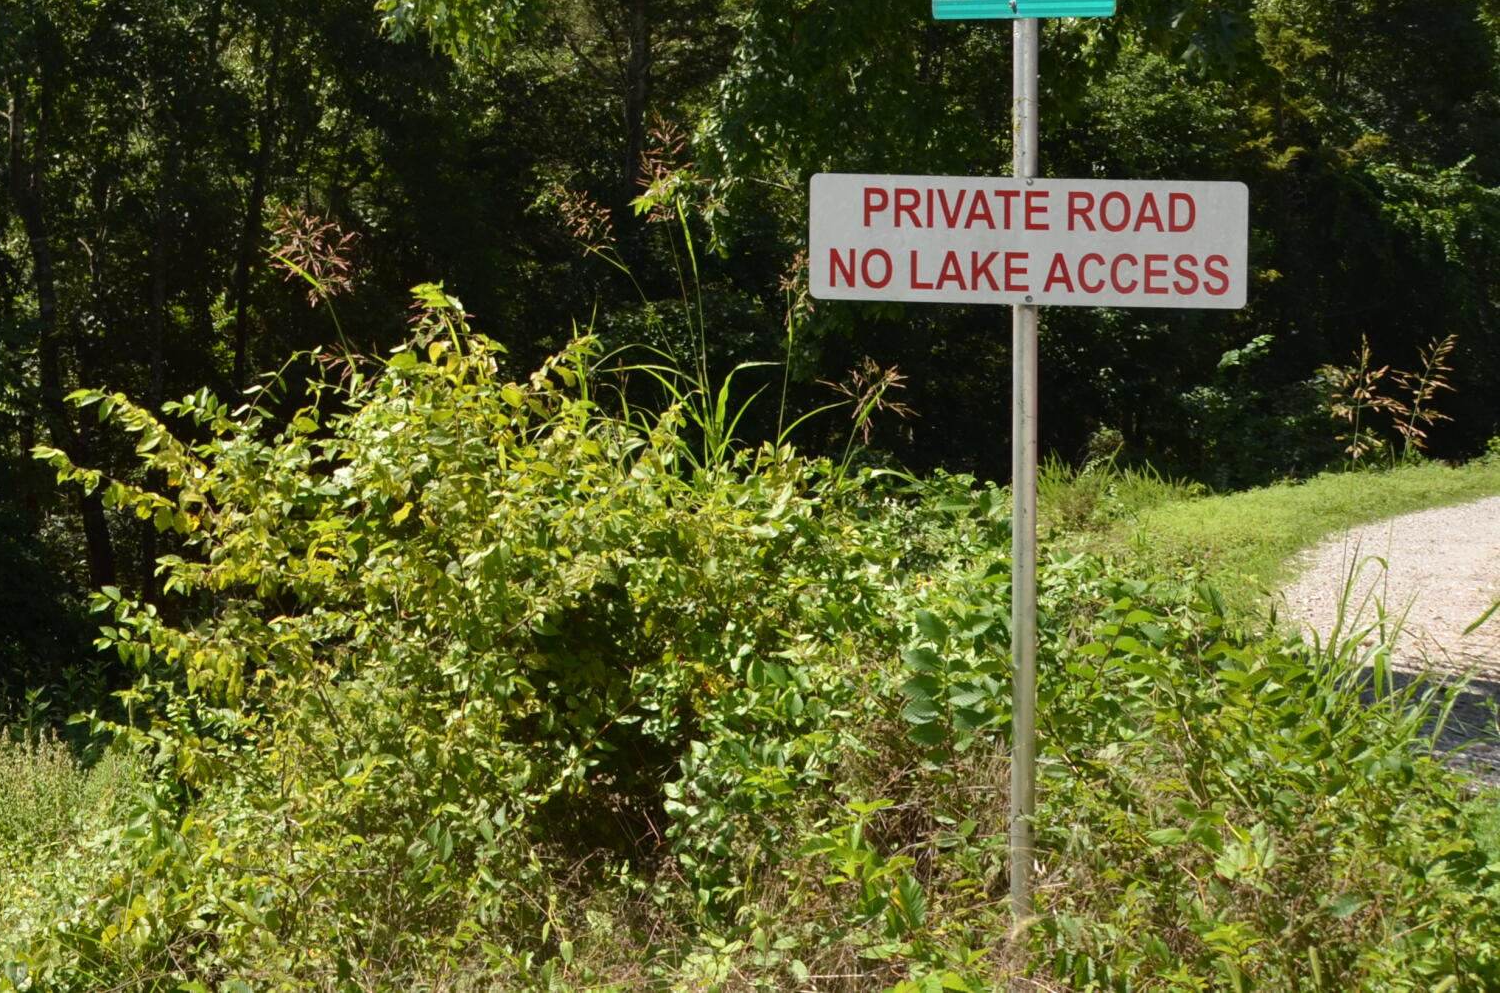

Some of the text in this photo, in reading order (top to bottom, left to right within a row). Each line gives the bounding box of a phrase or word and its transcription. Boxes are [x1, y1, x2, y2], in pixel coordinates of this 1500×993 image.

[863, 187, 1196, 233] PRIVATE ROAD
[829, 248, 1230, 296] NO LAKE ACCESS
